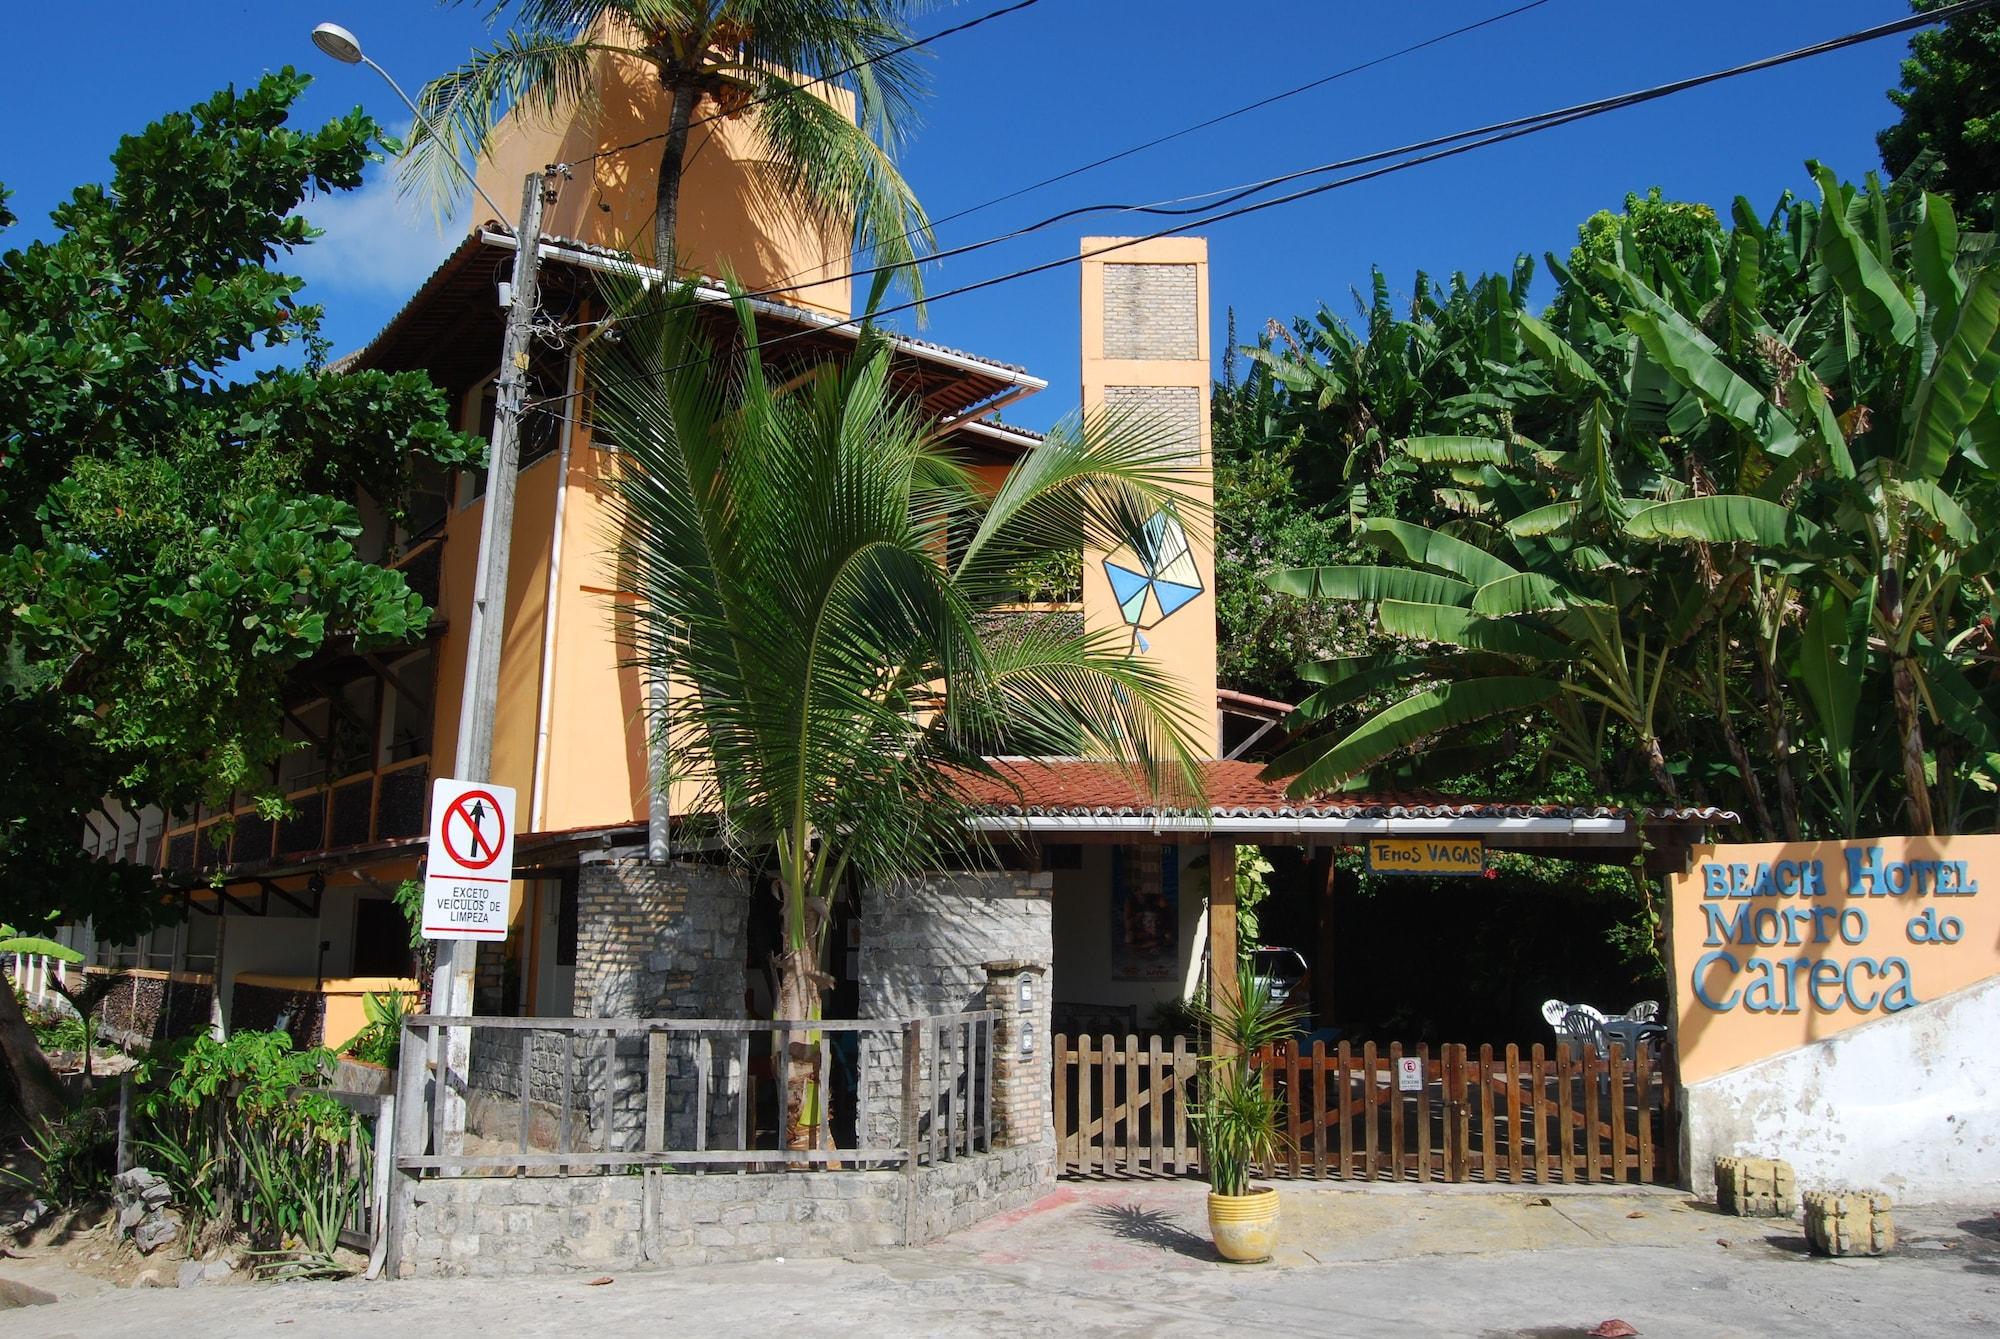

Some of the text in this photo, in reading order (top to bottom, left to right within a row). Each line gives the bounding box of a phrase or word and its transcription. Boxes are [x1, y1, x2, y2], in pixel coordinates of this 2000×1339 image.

[1426, 843, 1480, 864] VAGAS
[1701, 846, 1978, 897] BEACH HOTEL
[453, 886, 489, 899] EXCETO
[489, 901, 500, 911] DE
[450, 911, 489, 923] LIMPEZA
[1700, 902, 1965, 946] Morro do
[1692, 949, 1920, 1014] Careca
